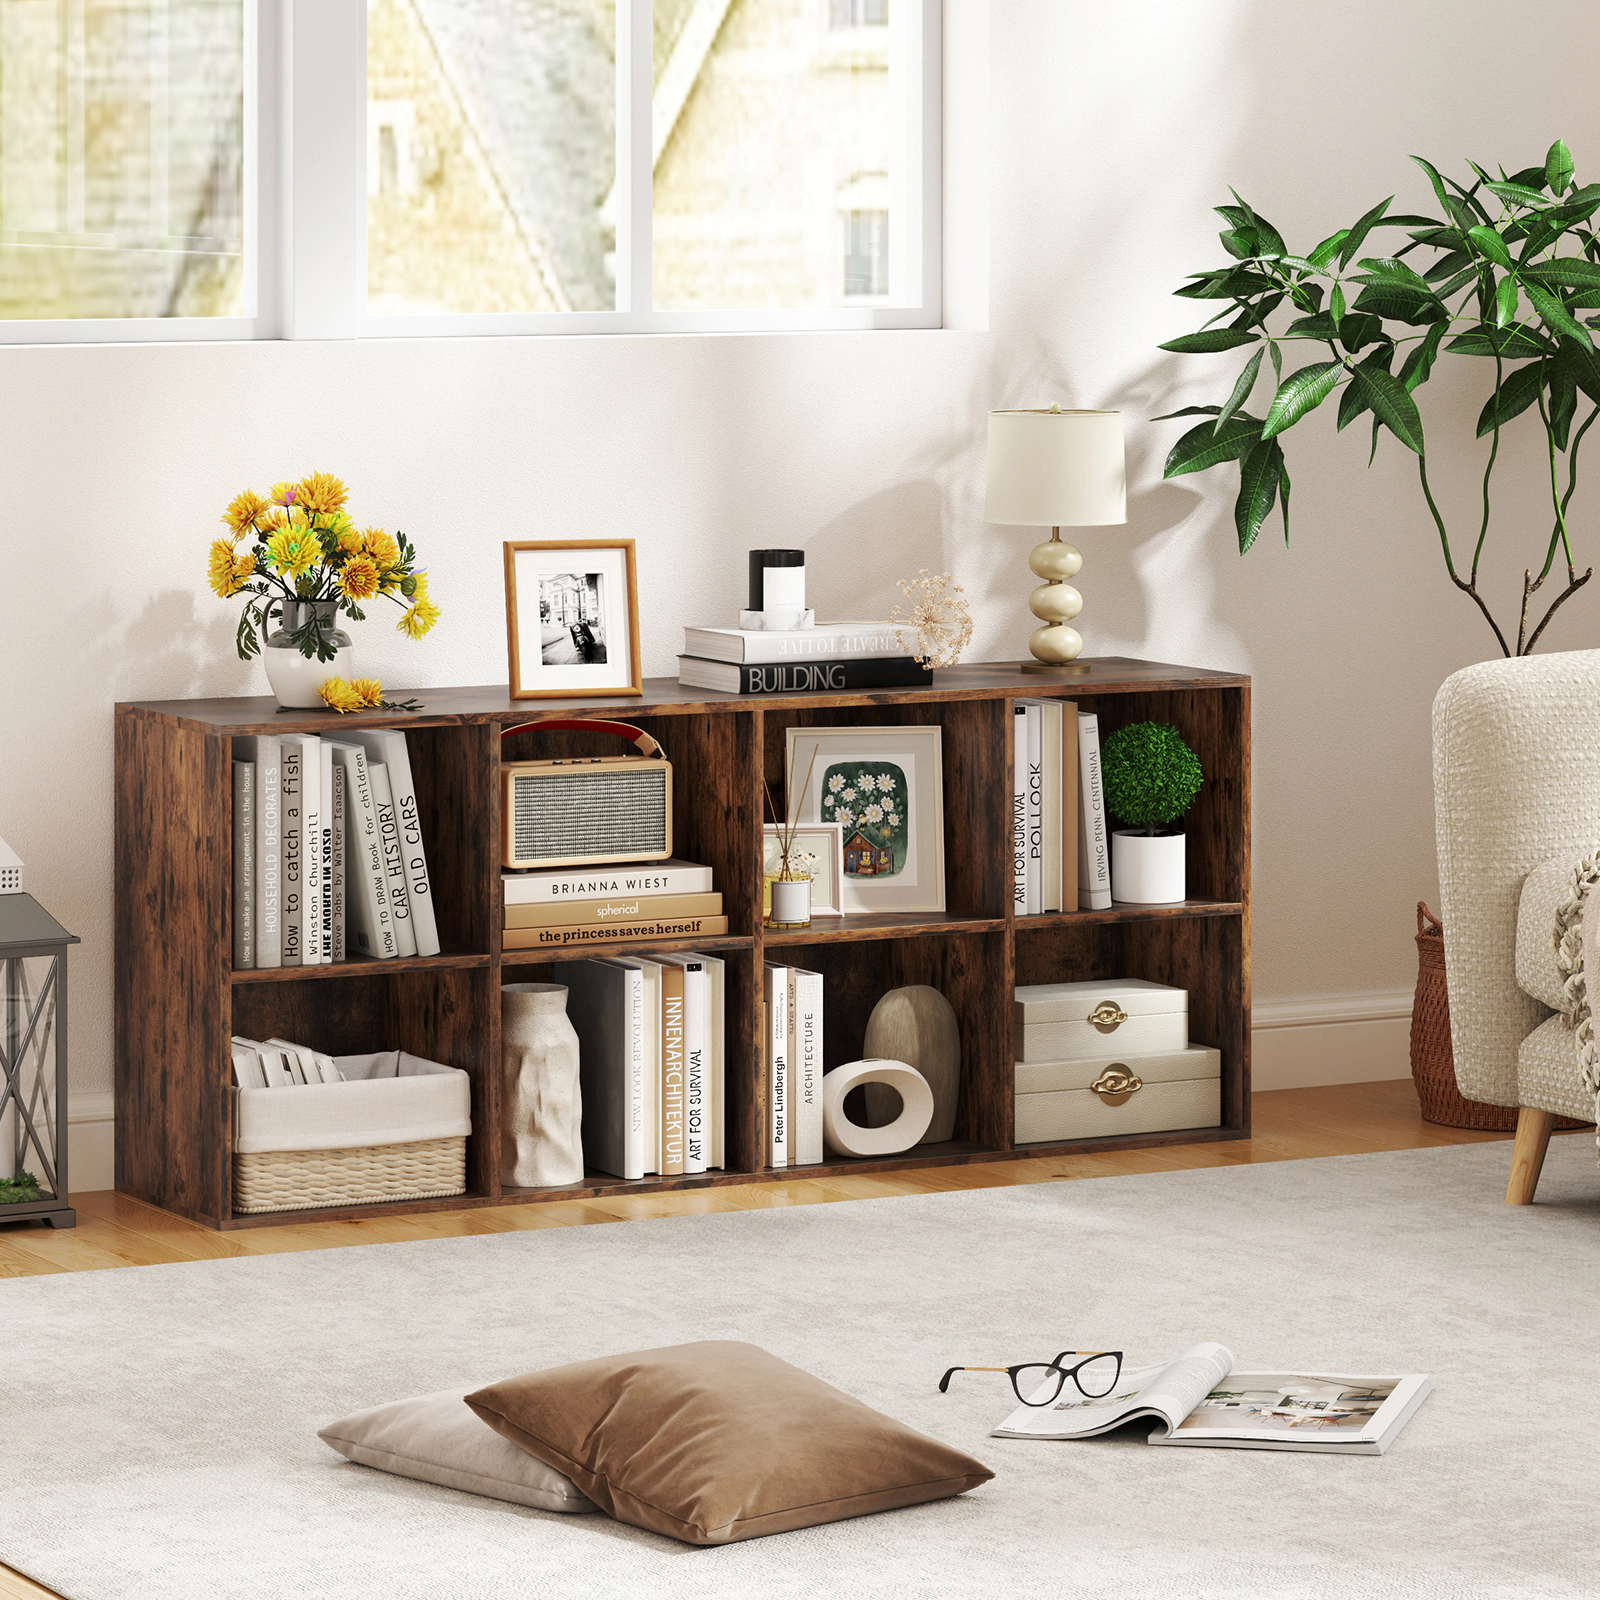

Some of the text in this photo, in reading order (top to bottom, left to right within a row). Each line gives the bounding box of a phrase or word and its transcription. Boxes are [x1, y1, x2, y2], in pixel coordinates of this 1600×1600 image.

[779, 636, 900, 654] CREATE TO LIVE
[749, 665, 845, 693] BUILDING
[1089, 750, 1101, 811] CENTENNIAL
[243, 816, 250, 827] in
[266, 767, 276, 933] HOUSEHOLD DECORATES
[400, 796, 428, 894] OLD CARS
[1015, 792, 1025, 903] ART FOR SURVIVAL
[243, 832, 252, 886] arrangement
[283, 754, 298, 957] How to catch a fish
[334, 873, 343, 886] by
[356, 753, 393, 953] HOW TO DRAW Book for children
[378, 803, 408, 919] CAR HISTORY
[1097, 845, 1106, 881] IRVING
[243, 892, 250, 901] an
[309, 812, 318, 955] Winston Churchill
[552, 878, 668, 894] BRIANNA WIEST
[597, 902, 638, 917] spherical
[243, 931, 250, 941] to
[539, 921, 701, 942] the princess saves herself
[666, 997, 681, 1164] INNENARCHITEKTUR
[690, 1049, 701, 1160] ART FOR SURVIVAL
[774, 1057, 785, 1143] Peter Lindbergh
